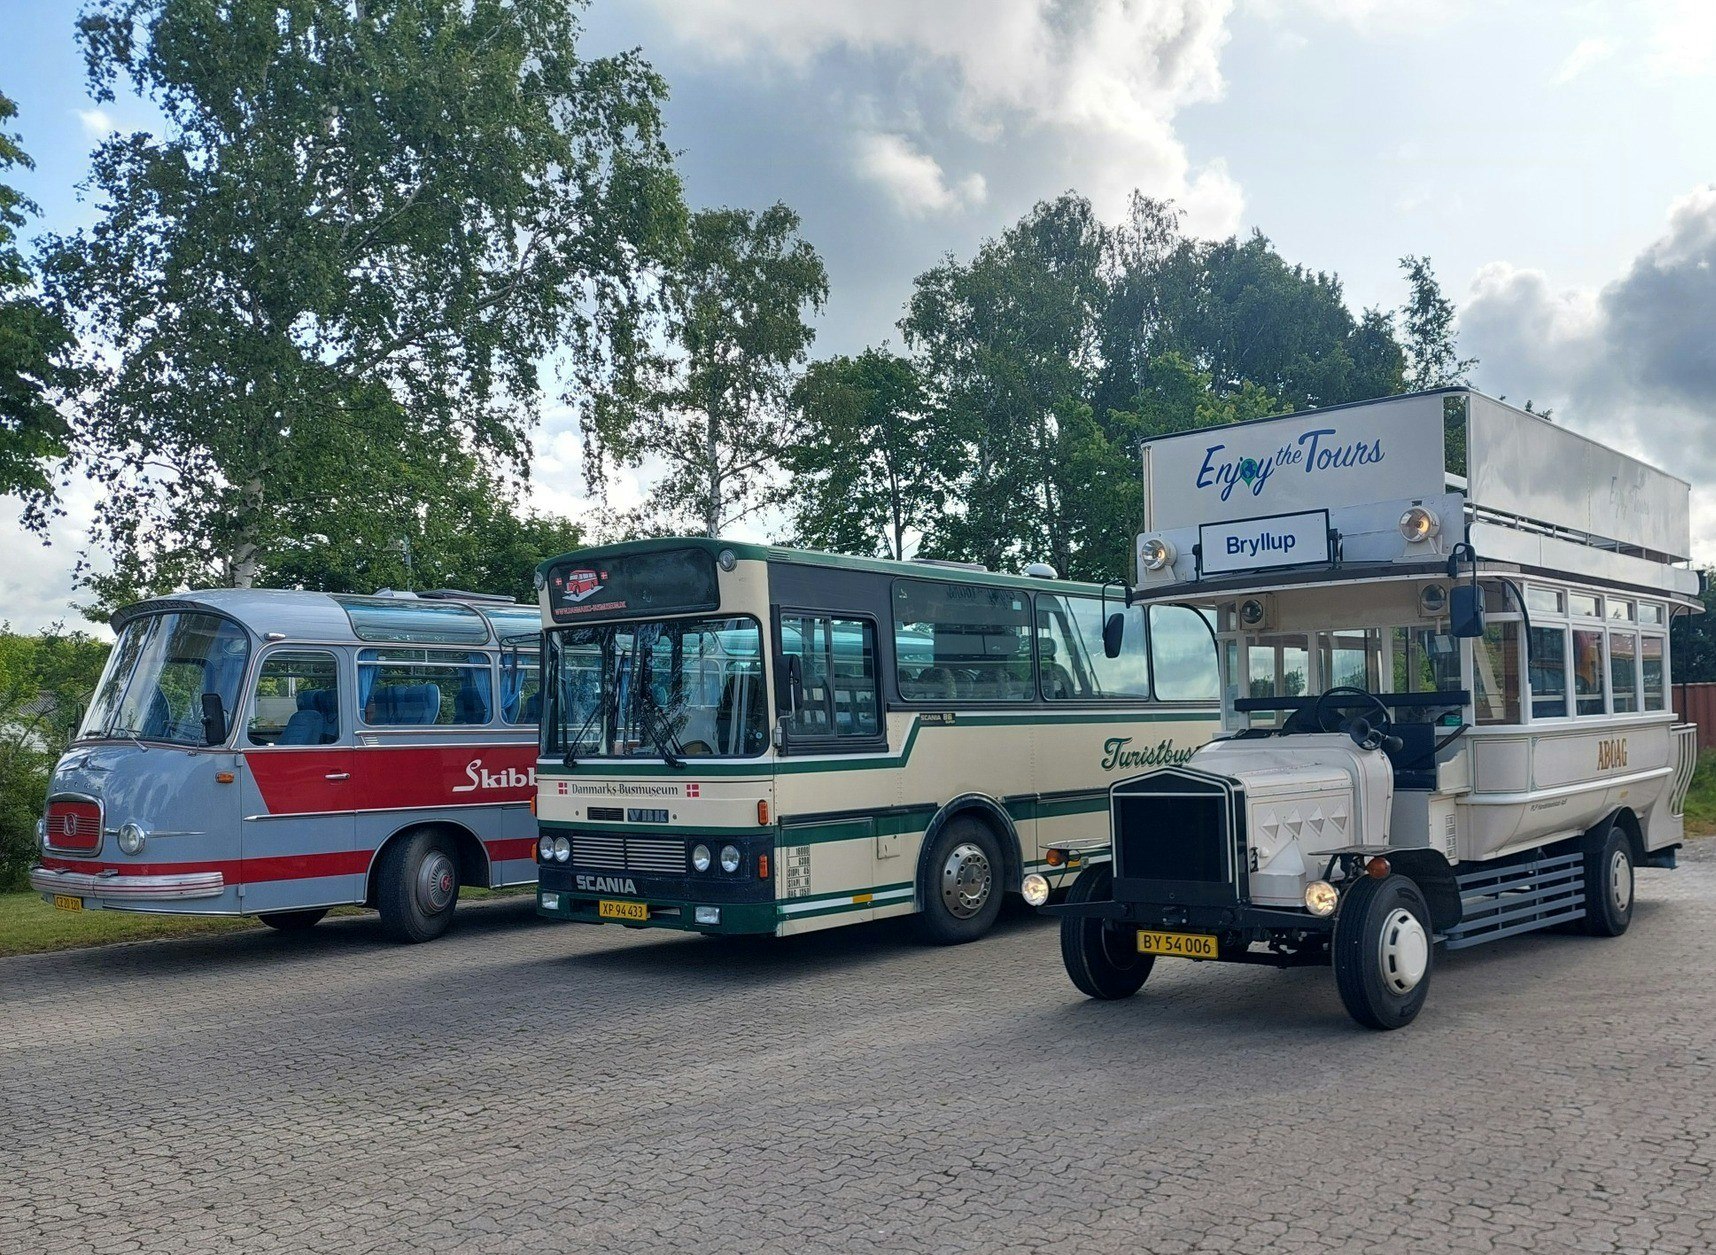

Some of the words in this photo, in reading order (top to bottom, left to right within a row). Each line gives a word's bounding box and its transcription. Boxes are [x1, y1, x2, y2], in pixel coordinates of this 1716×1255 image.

[1196, 444, 1275, 502] Enjoy
[1276, 443, 1302, 467] the
[1298, 428, 1385, 473] Tours
[1226, 532, 1296, 557] Bryllup
[1101, 737, 1192, 771] Turistbus
[1597, 738, 1628, 771] ABOAG
[576, 874, 637, 895] SCANIA
[602, 903, 614, 915] XP
[615, 904, 626, 917] 94
[627, 905, 643, 918] 433
[1143, 934, 1162, 950] BY
[1165, 936, 1182, 952] 54
[1185, 938, 1211, 954] 006
